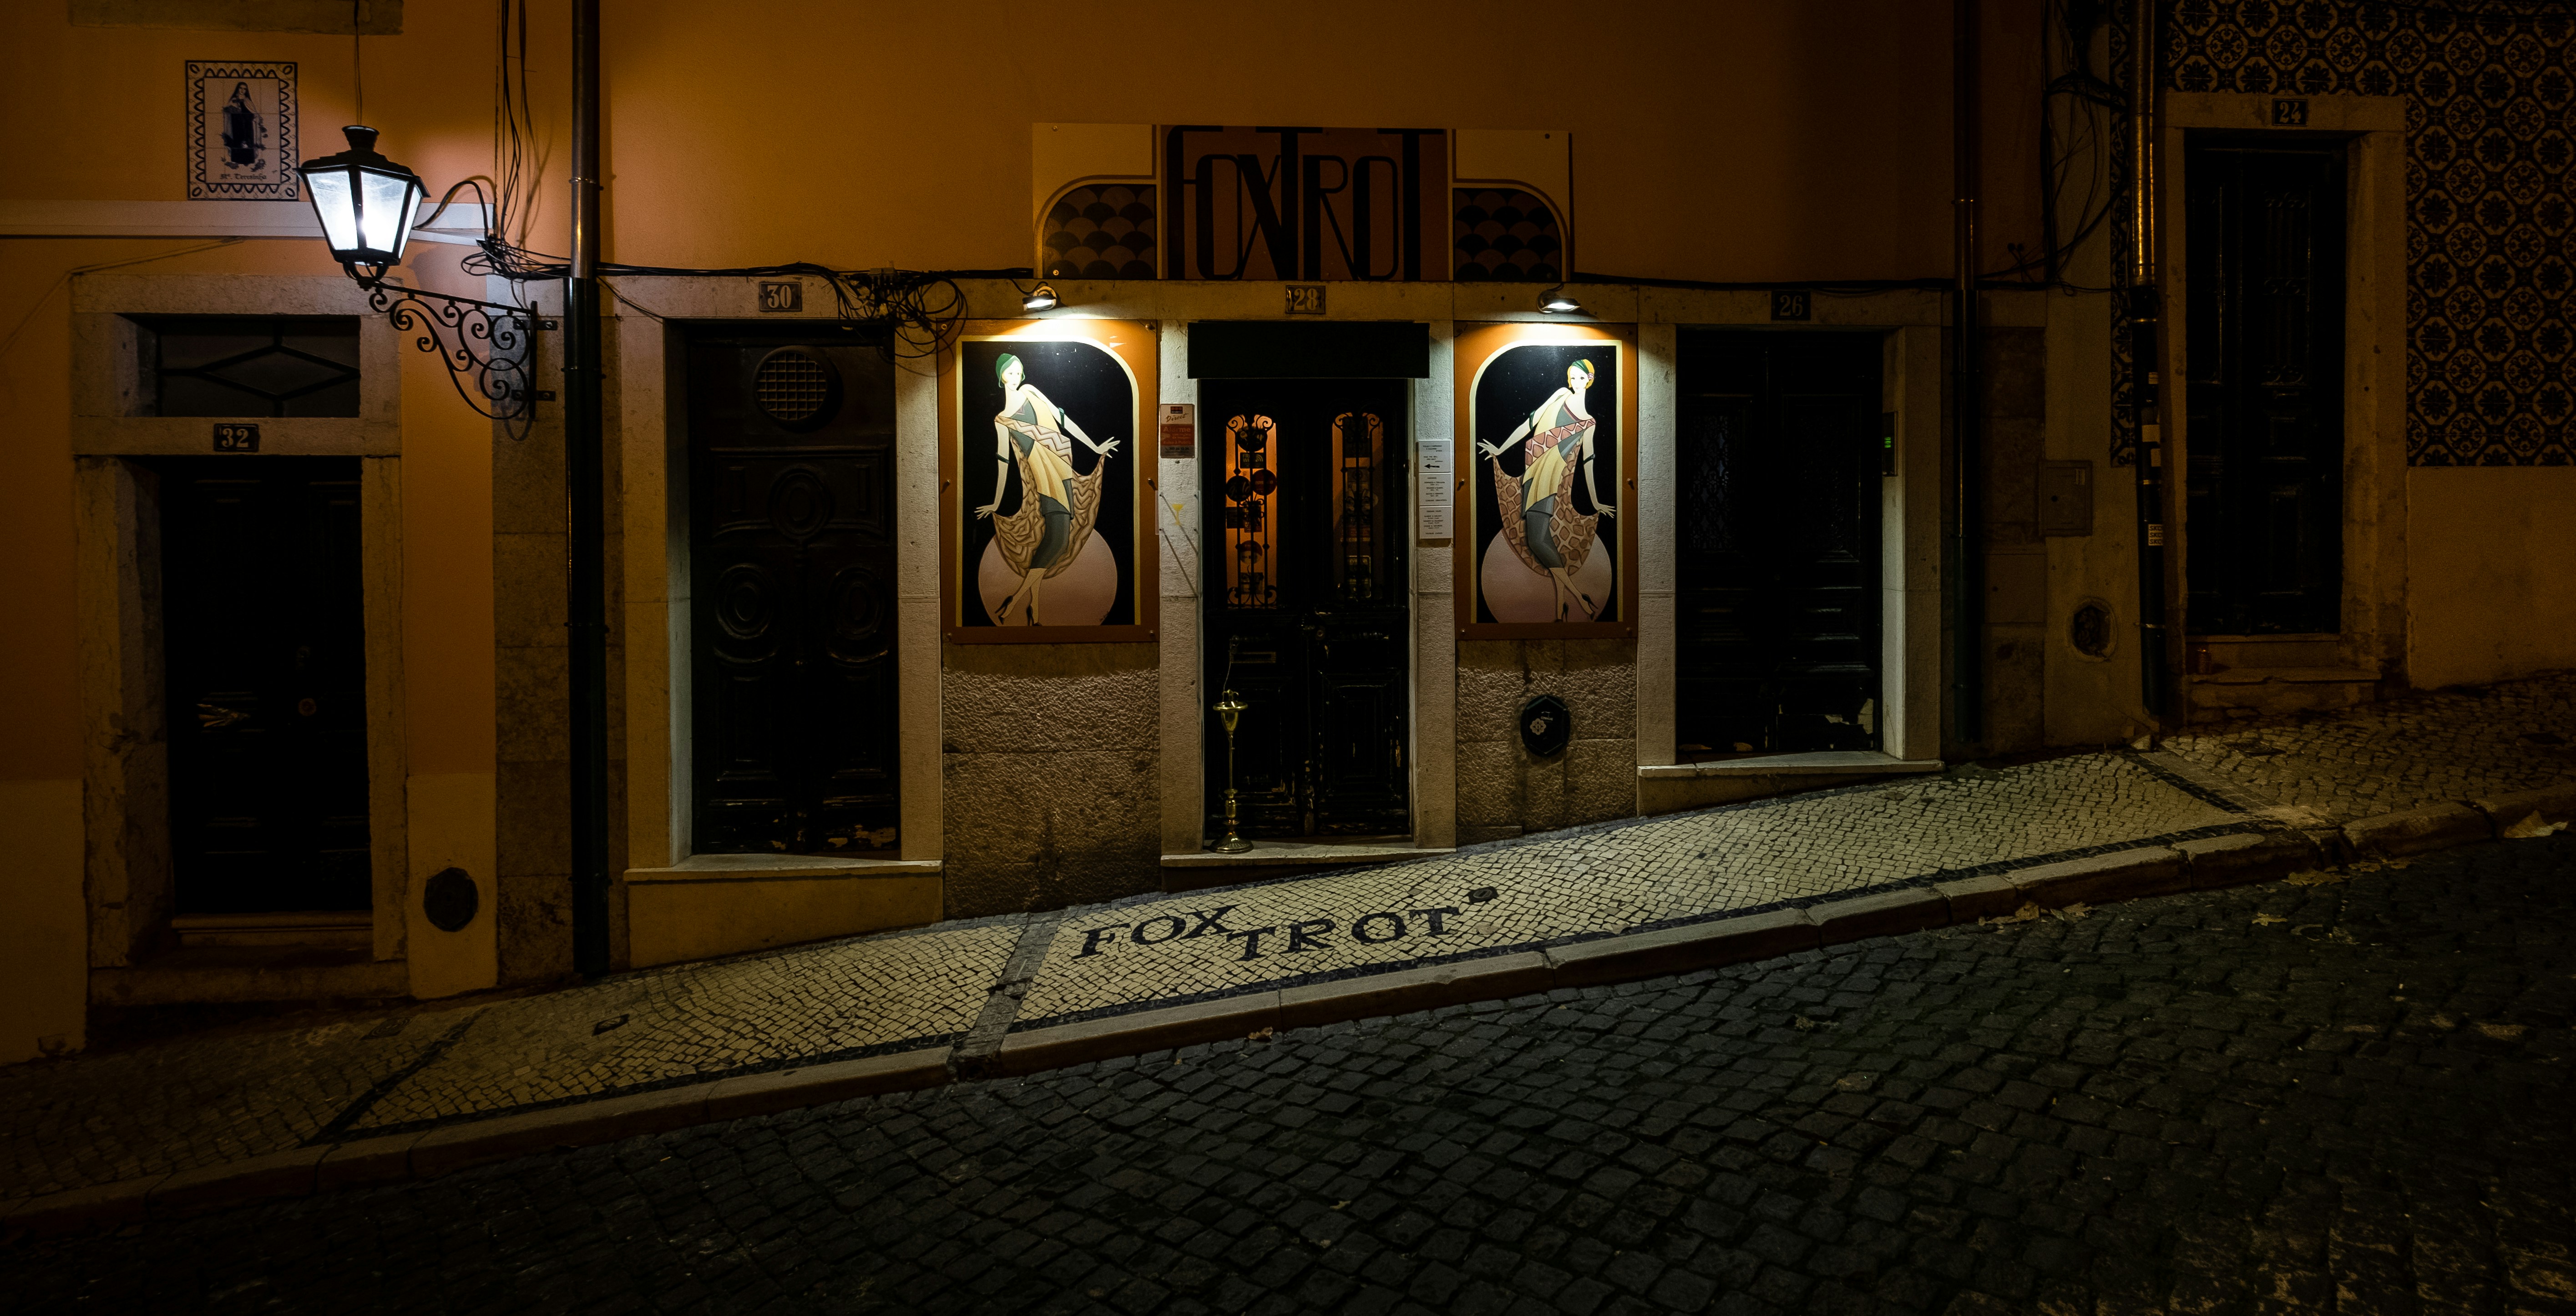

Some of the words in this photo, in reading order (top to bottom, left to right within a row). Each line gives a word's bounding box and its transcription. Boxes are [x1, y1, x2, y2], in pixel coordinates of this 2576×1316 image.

[2279, 102, 2302, 123] 24
[1167, 125, 1444, 280] FOXTROT
[767, 285, 792, 308] 30
[1294, 288, 1318, 311] 28
[1779, 295, 1803, 316] 26
[222, 428, 249, 448] 32
